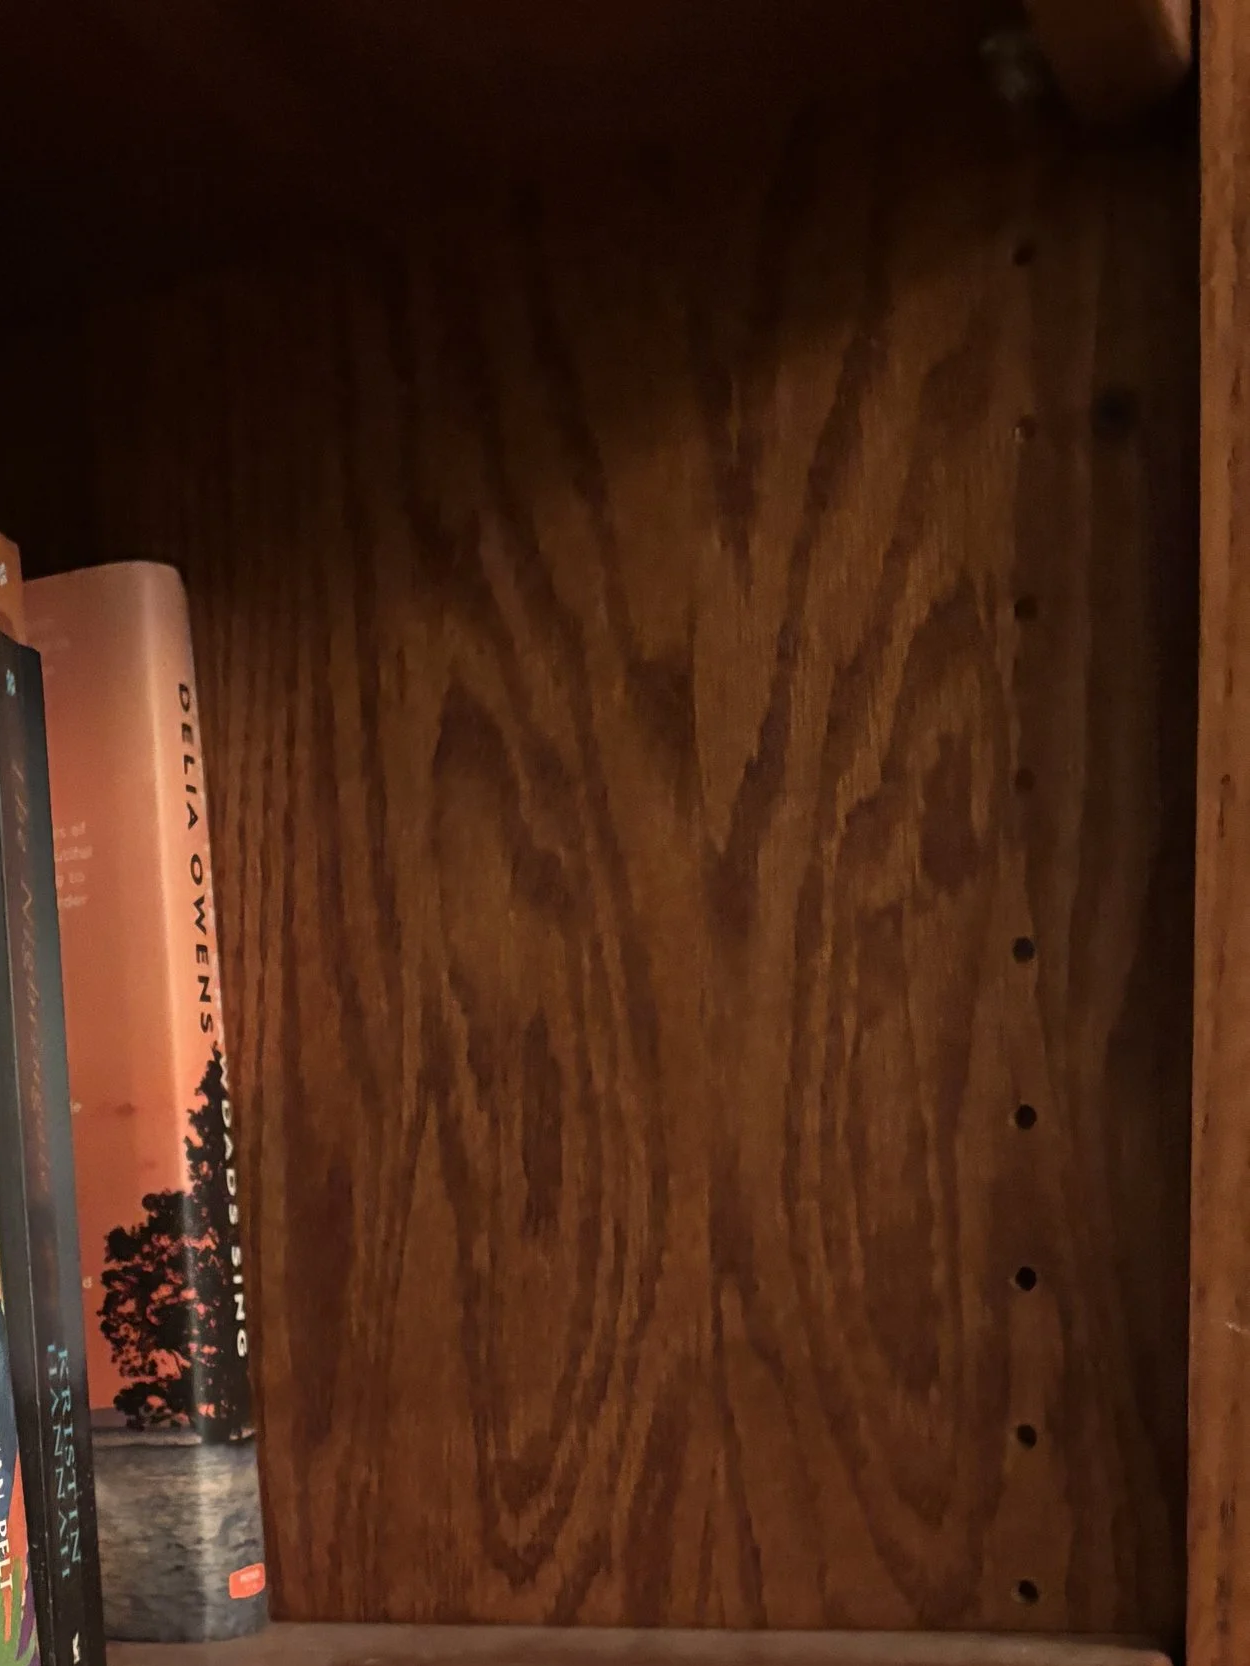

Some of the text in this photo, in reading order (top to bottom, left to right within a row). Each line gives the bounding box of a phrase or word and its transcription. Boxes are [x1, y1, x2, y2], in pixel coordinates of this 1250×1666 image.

[178, 682, 215, 1035] DELIA OWENS
[230, 1245, 249, 1359] SING
[57, 1349, 82, 1565] KRISTIN
